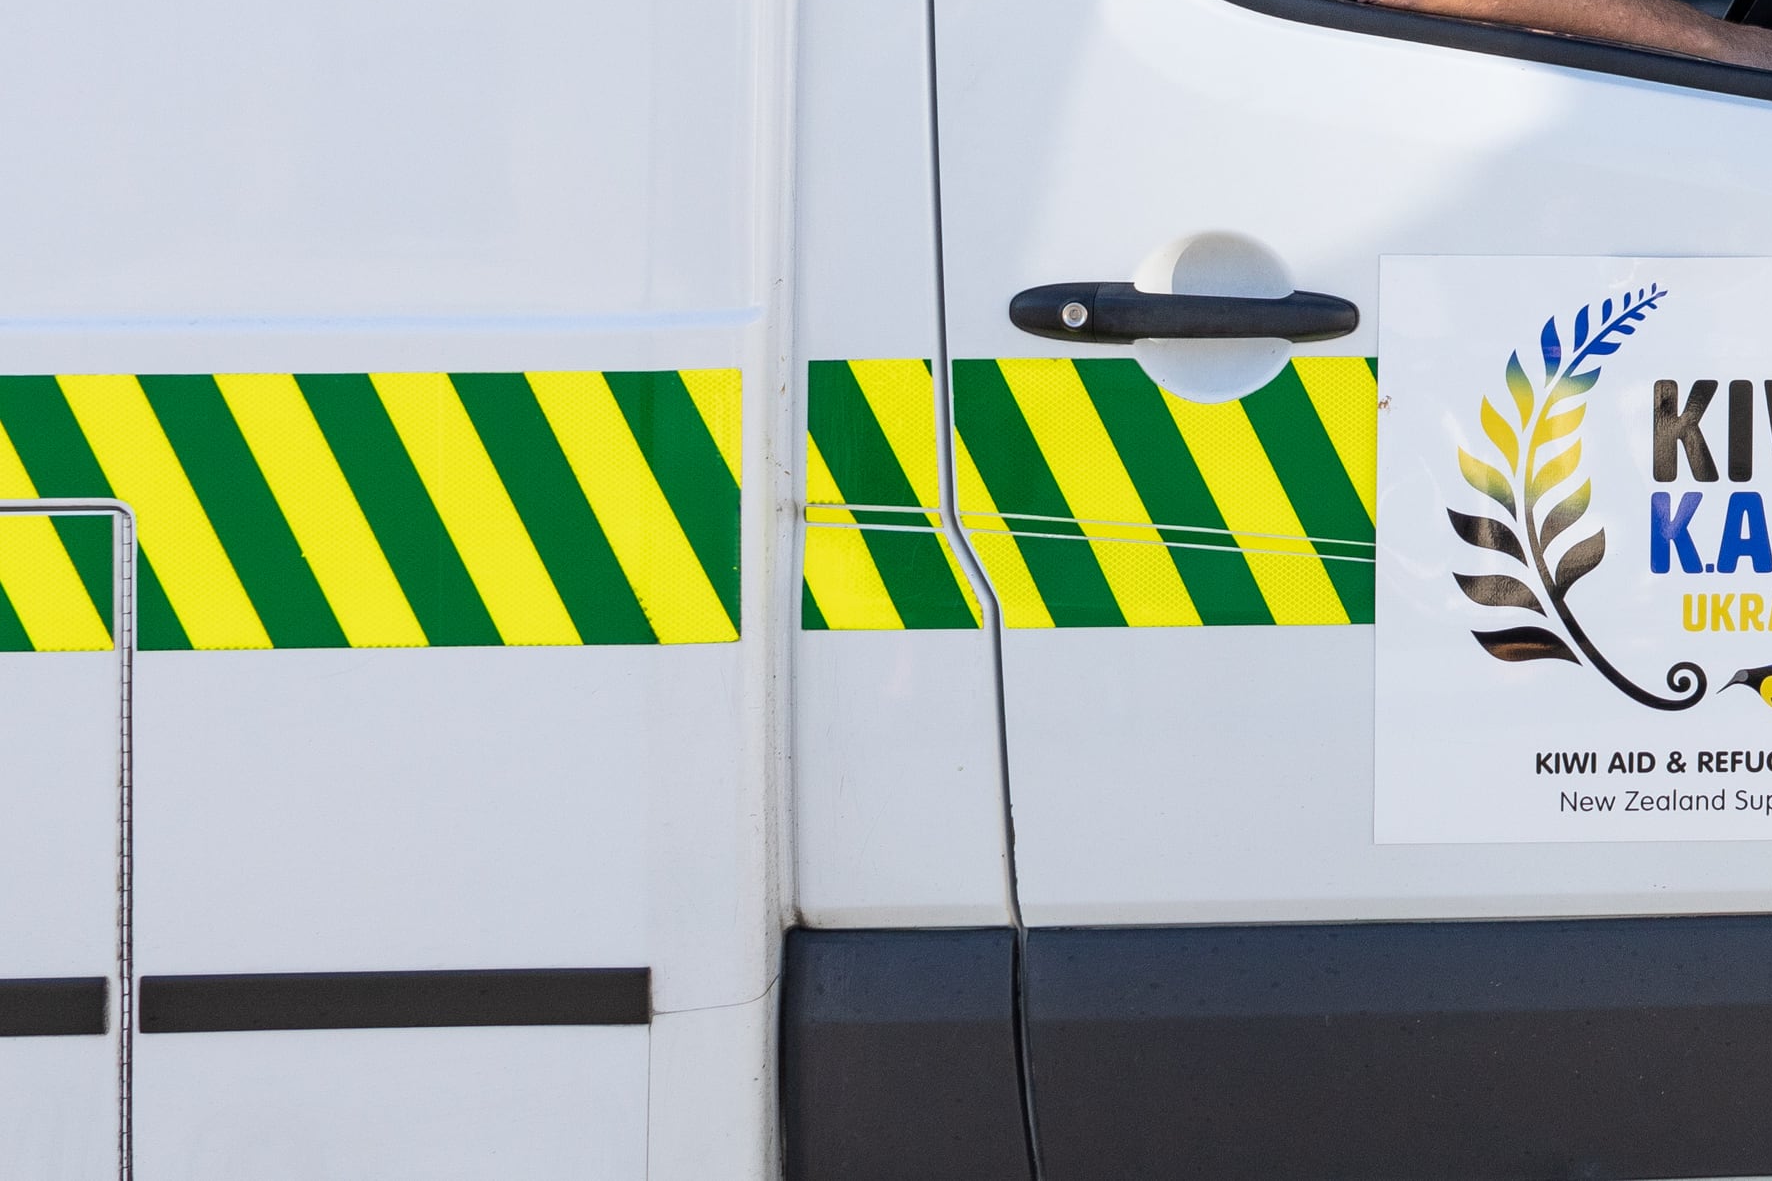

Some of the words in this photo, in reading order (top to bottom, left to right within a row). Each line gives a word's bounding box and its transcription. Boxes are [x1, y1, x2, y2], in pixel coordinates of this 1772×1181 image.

[1535, 751, 1597, 774] KIWI
[1607, 751, 1656, 774] AID
[1666, 750, 1687, 773] &
[1560, 791, 1616, 812] New
[1624, 788, 1726, 812] Zealand
